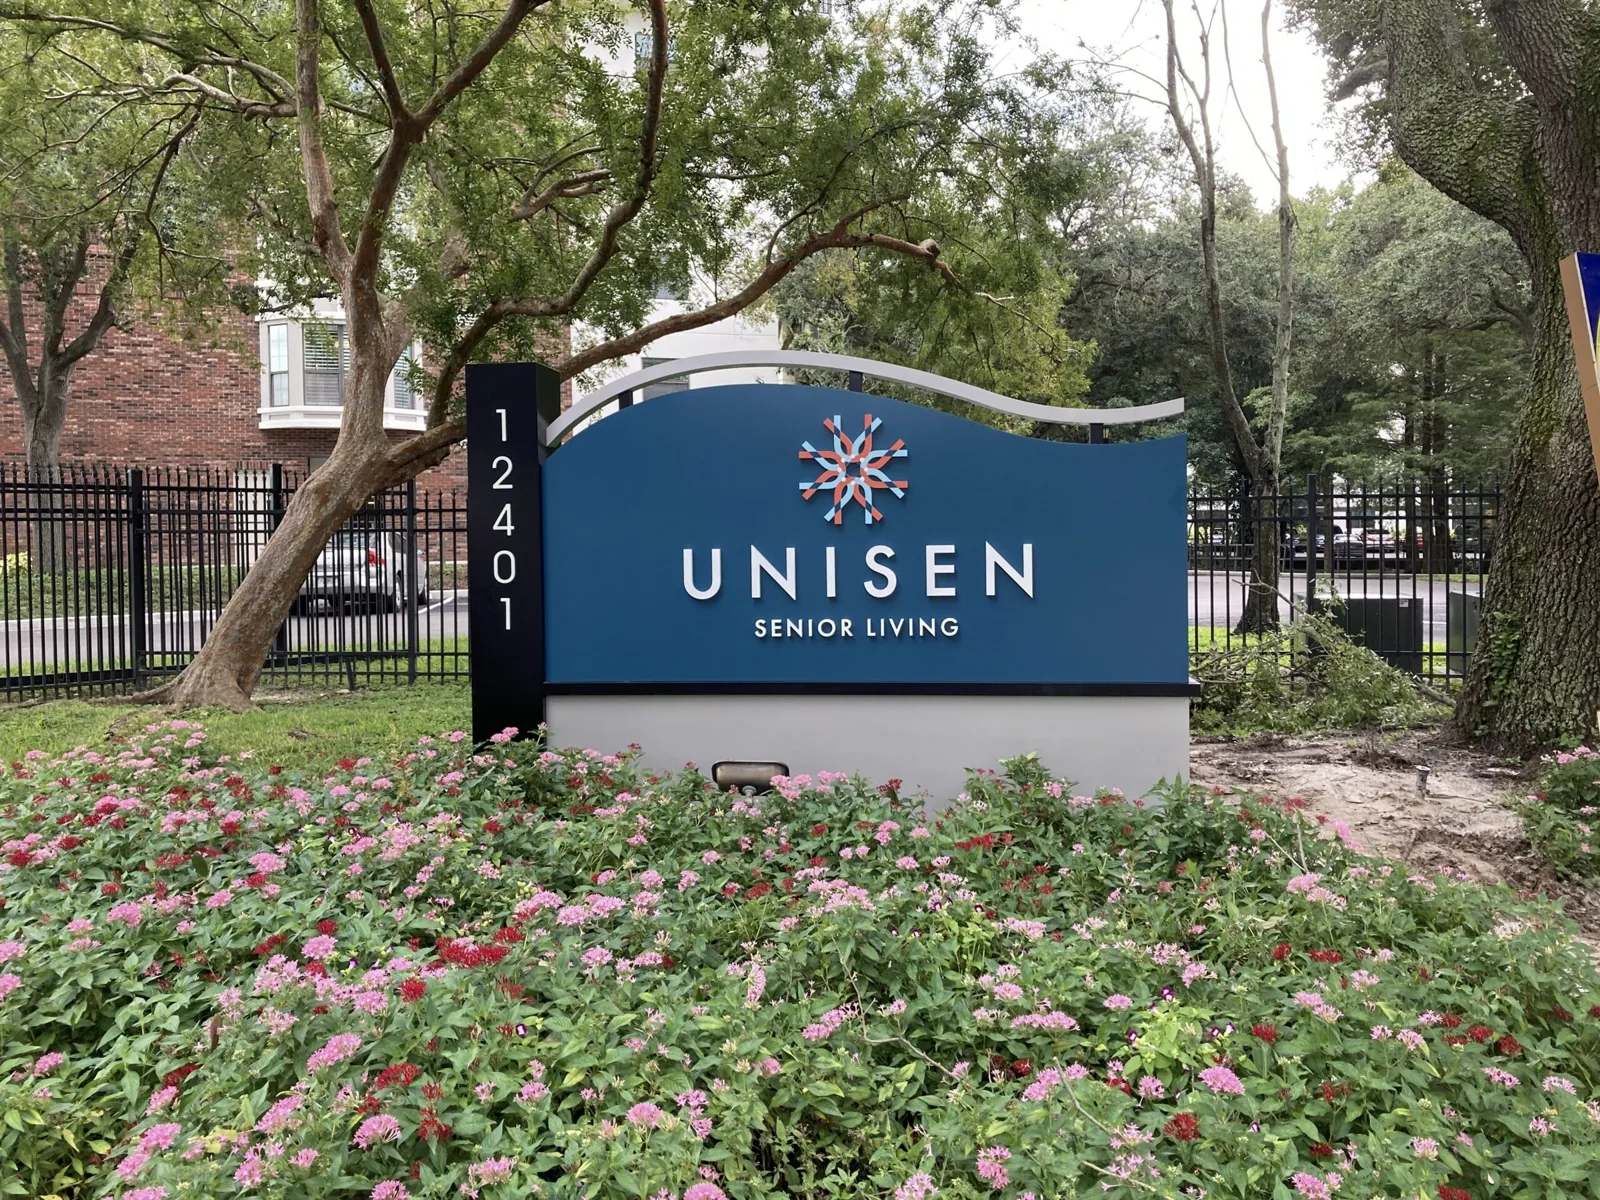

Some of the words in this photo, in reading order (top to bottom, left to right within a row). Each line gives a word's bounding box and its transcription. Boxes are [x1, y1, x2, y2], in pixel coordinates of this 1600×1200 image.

[491, 407, 518, 631] 12401
[682, 541, 1035, 601] UNISEN
[753, 618, 855, 639] SENIOR
[865, 616, 961, 638] LIVING
